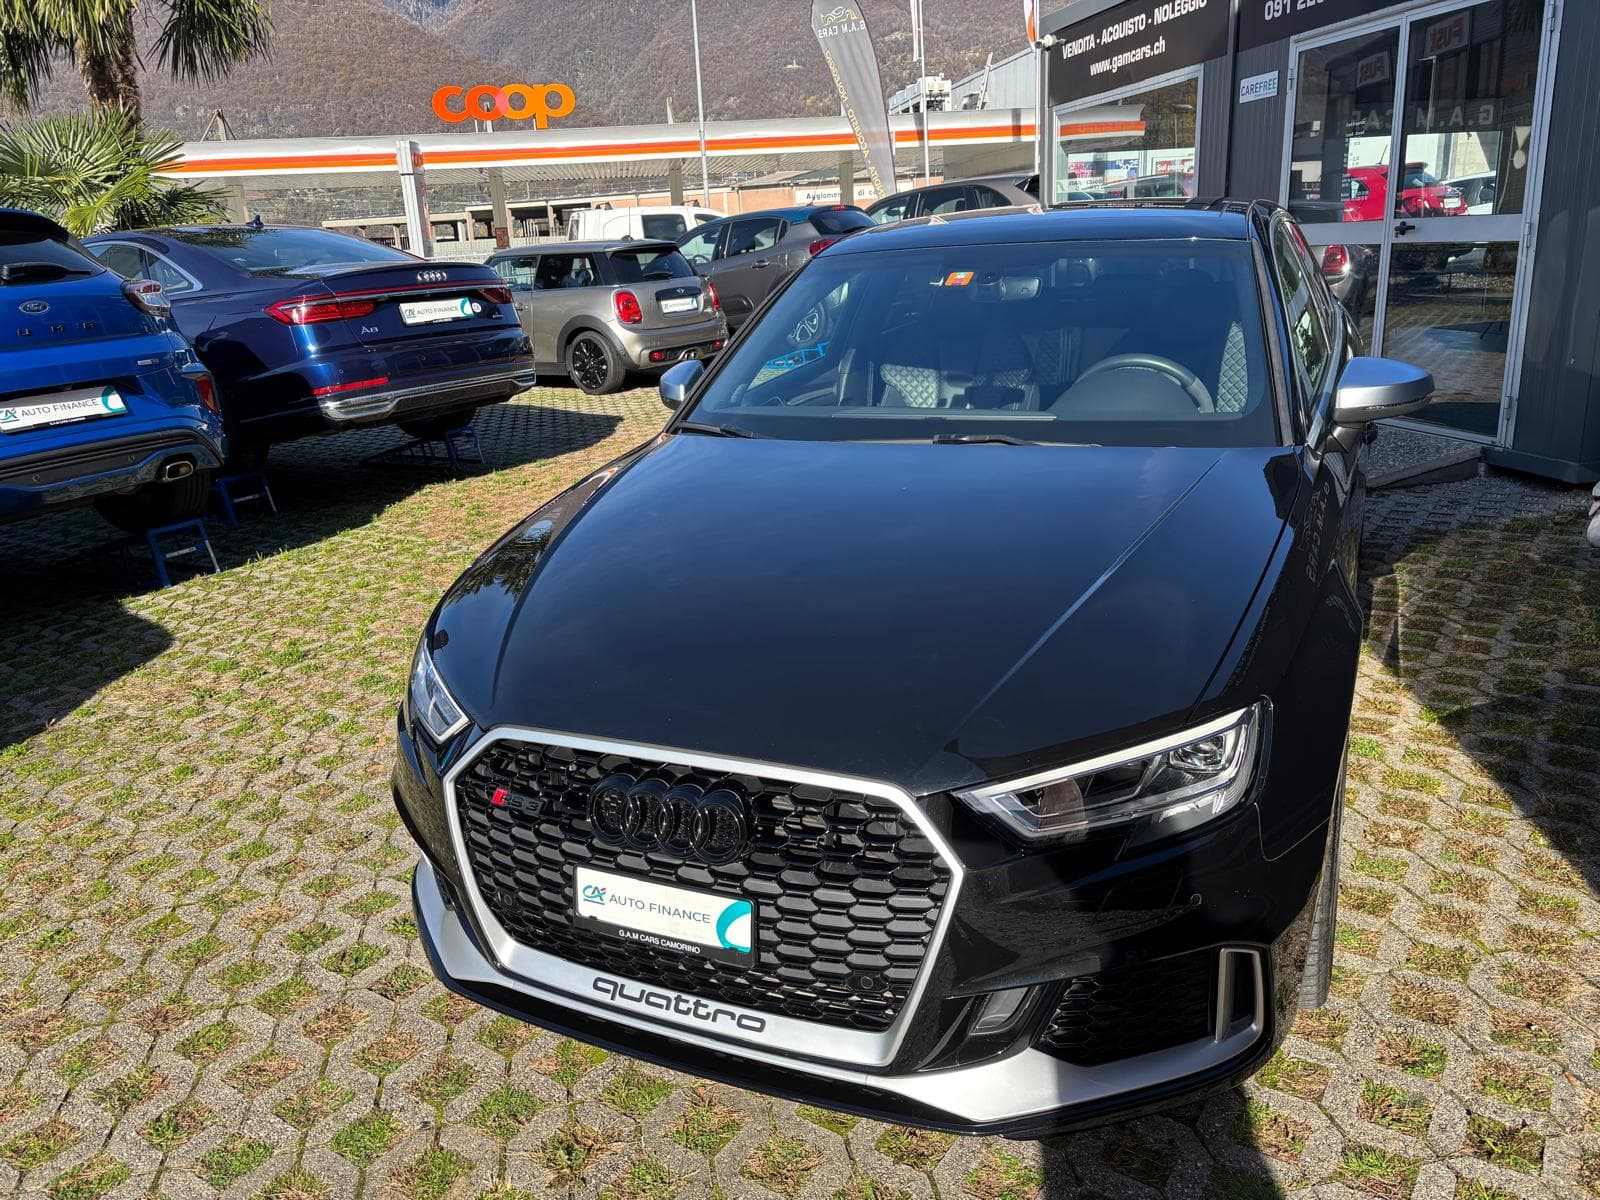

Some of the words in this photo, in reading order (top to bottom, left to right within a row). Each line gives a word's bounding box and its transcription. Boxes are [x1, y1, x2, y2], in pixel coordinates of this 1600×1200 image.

[1264, 0, 1290, 20] 091
[1062, 34, 1095, 59] VENDITA
[1101, 13, 1146, 46] ACQUISTO
[1090, 36, 1166, 77] www.gamcars.ch
[1241, 77, 1277, 96] CAREFREE
[431, 83, 576, 129] coop
[361, 326, 379, 335] A8
[21, 405, 51, 418] AUTO
[53, 398, 100, 413] FINANCE
[609, 893, 645, 910] AUTO
[650, 902, 711, 924] FINANCE
[618, 929, 639, 941] G.A.M
[639, 933, 660, 945] CARS
[660, 937, 701, 954] CAMORINO
[592, 976, 766, 1033] quattro
